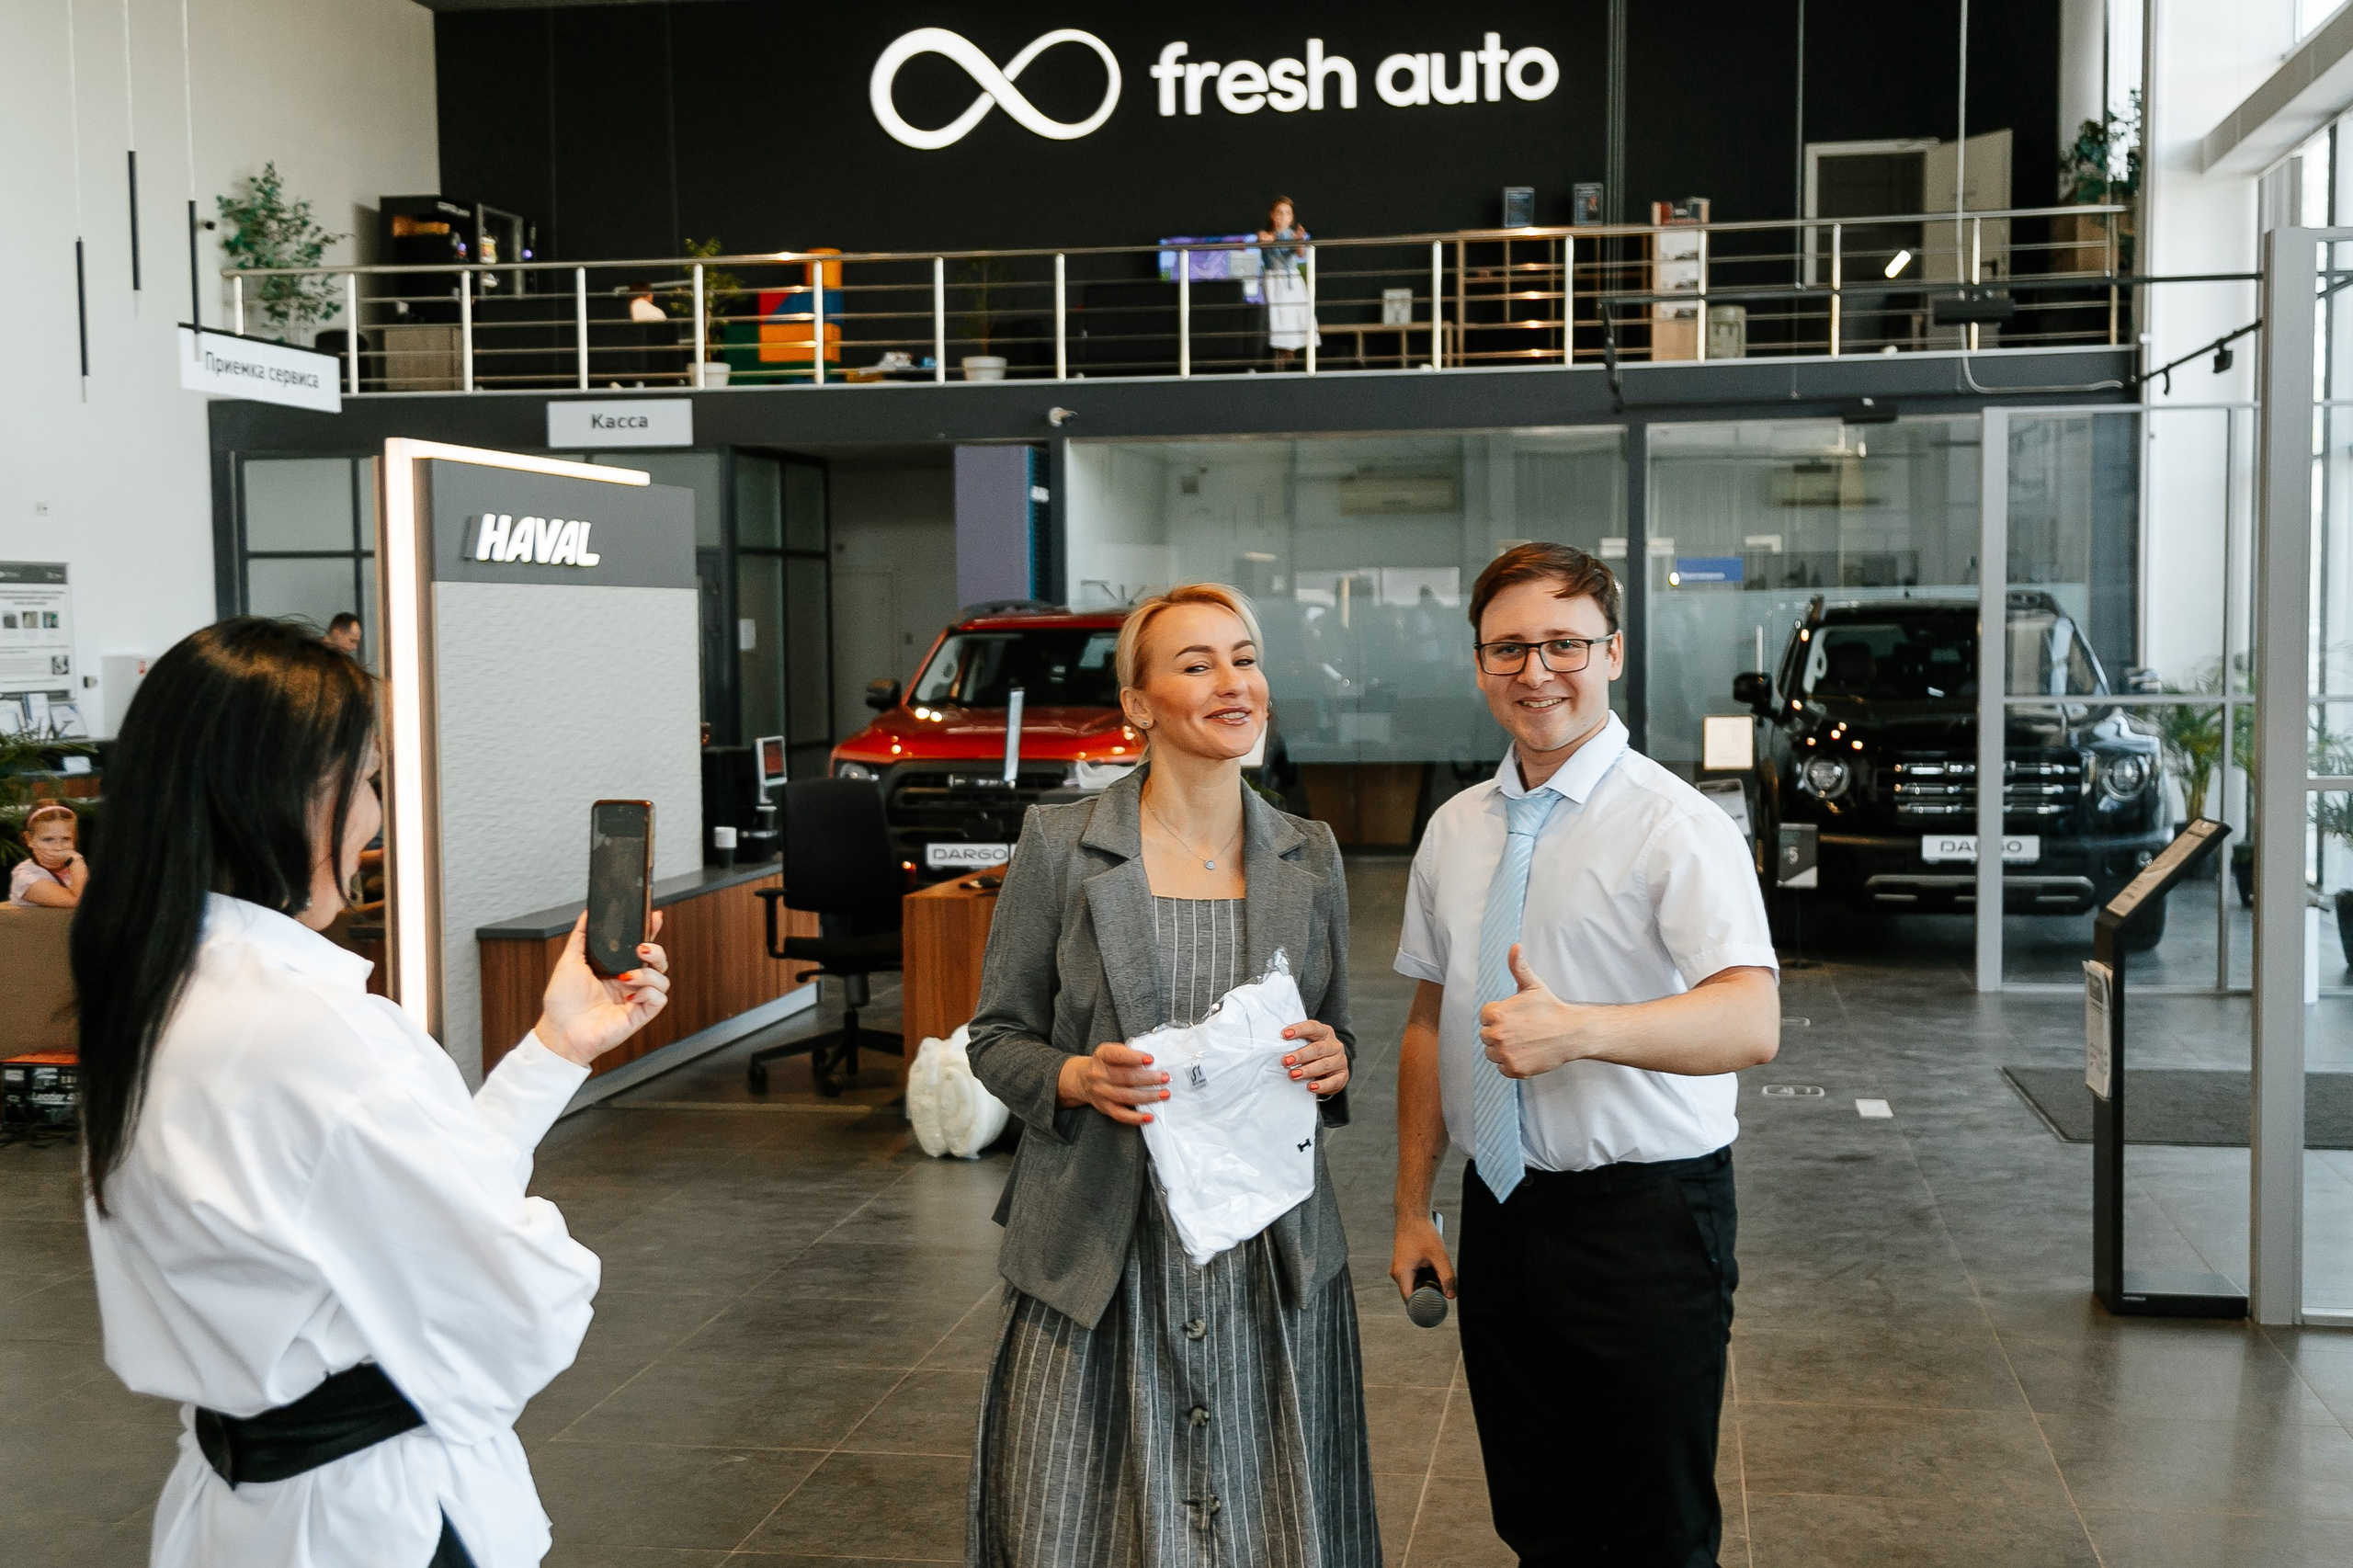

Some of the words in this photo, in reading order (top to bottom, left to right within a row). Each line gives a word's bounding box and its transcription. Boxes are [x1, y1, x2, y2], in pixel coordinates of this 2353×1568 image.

[1150, 38, 1358, 117] fresh
[1375, 31, 1560, 108] auto
[205, 350, 266, 380] Приемка
[269, 366, 320, 389] сервиса
[591, 413, 649, 429] Касса
[475, 513, 601, 567] HAVAL
[933, 847, 1008, 860] DARGO
[1940, 840, 2023, 853] DAO
